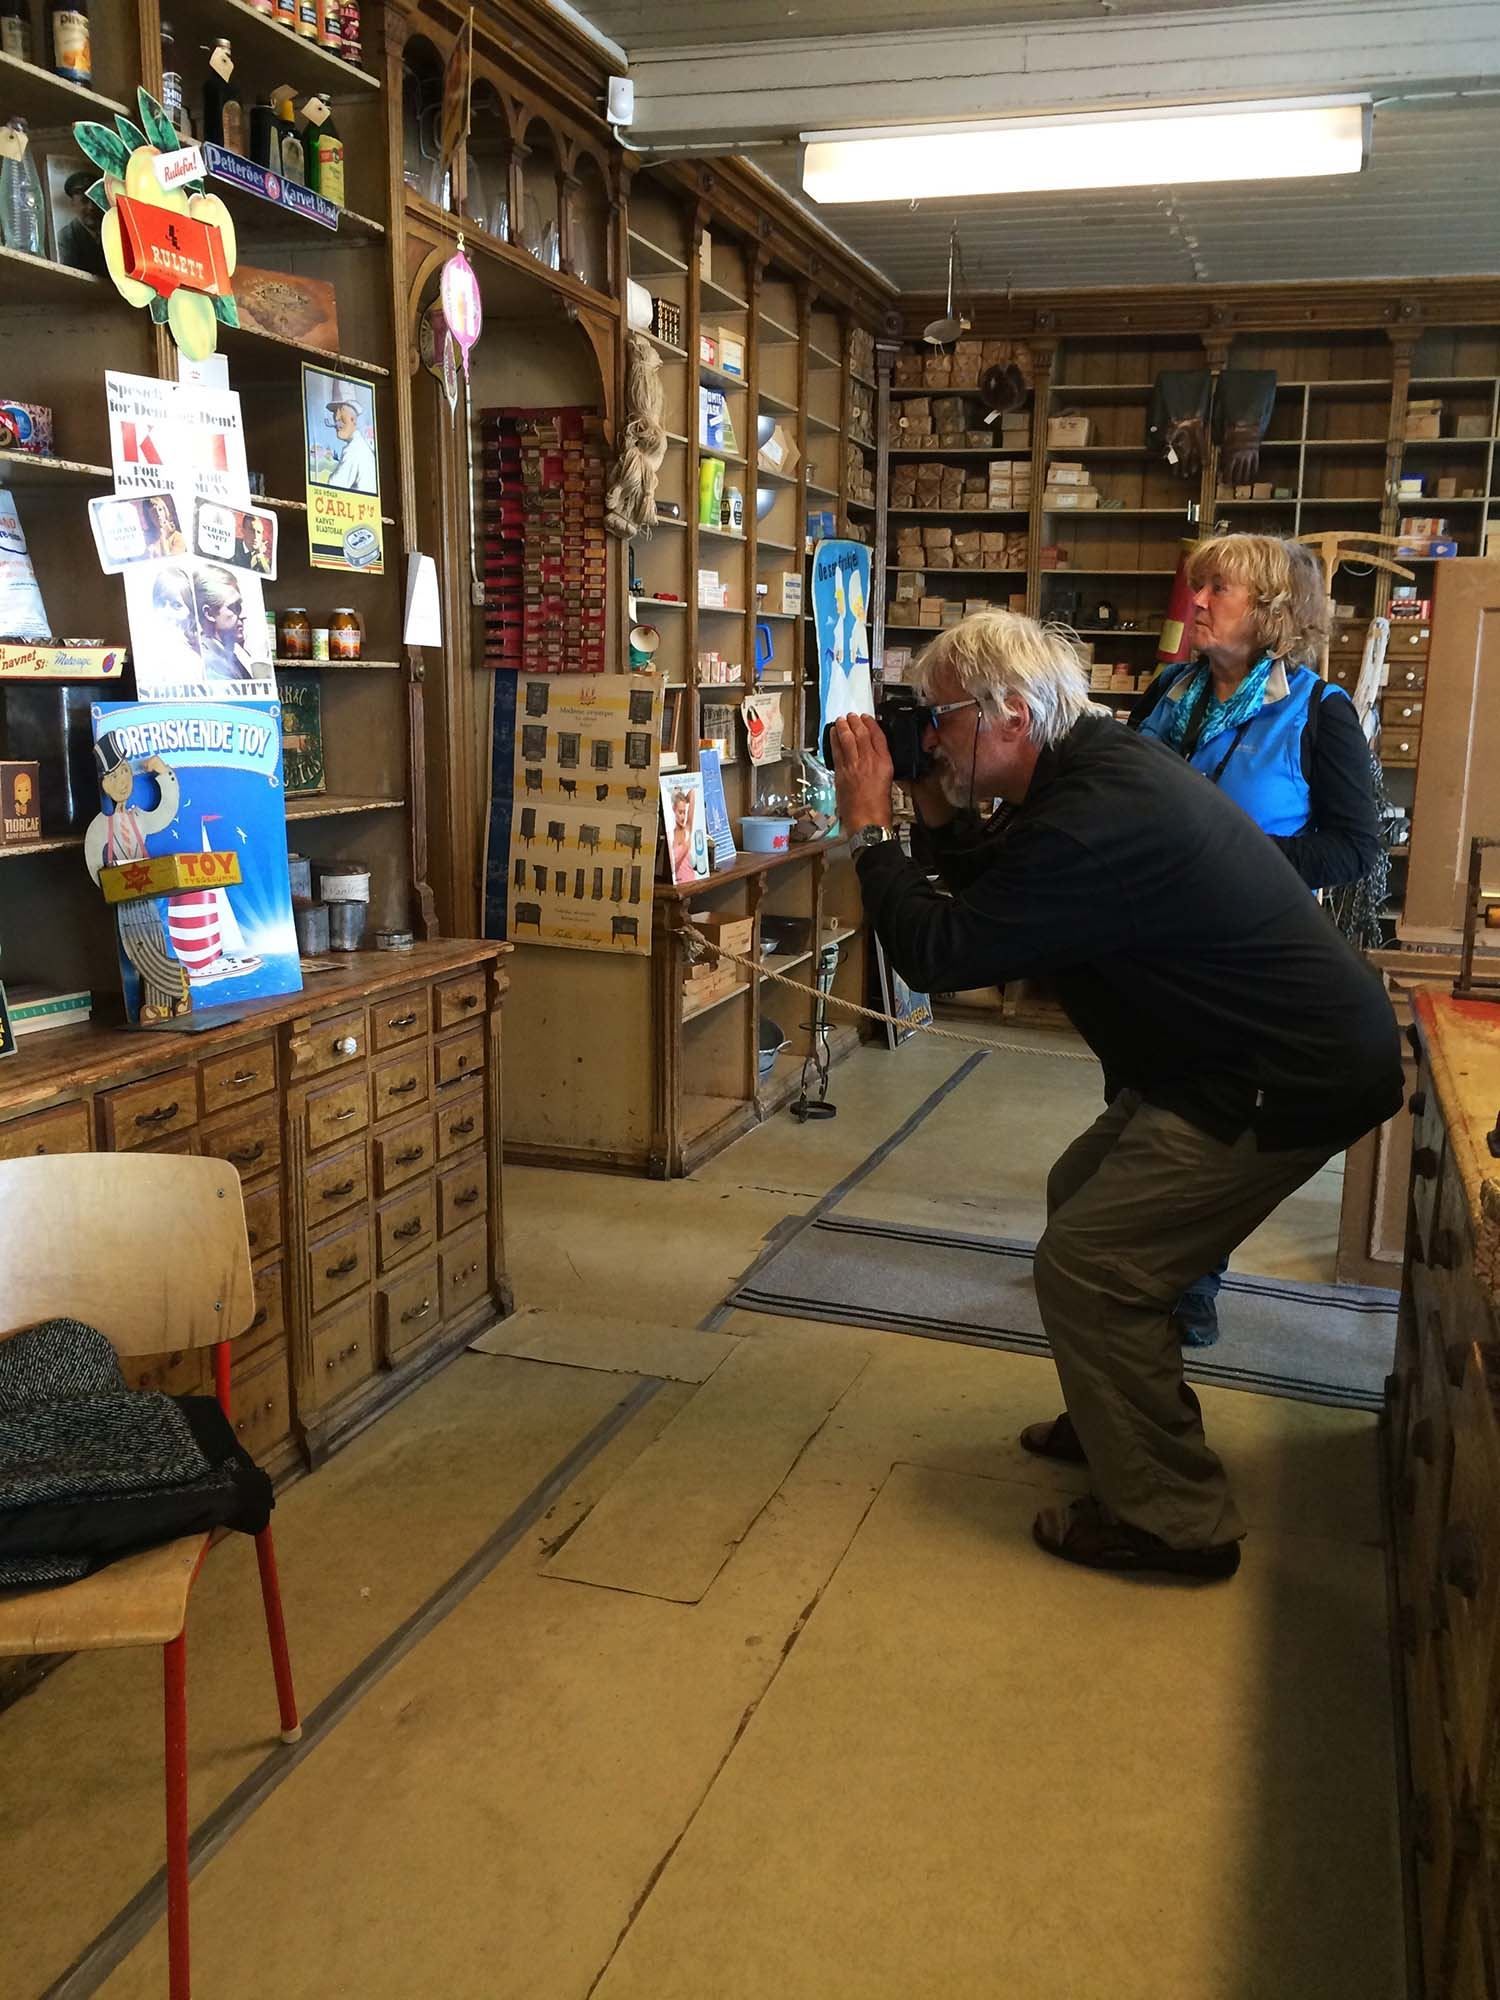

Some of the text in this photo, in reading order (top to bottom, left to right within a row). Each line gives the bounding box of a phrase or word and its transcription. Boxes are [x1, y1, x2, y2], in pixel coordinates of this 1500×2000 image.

[151, 245, 205, 280] RULETT
[117, 475, 175, 491] KVINNER
[133, 465, 159, 477] FOR
[315, 496, 355, 522] CARL
[115, 718, 272, 760] ORFRISKENDE TOY
[180, 853, 234, 877] TOY
